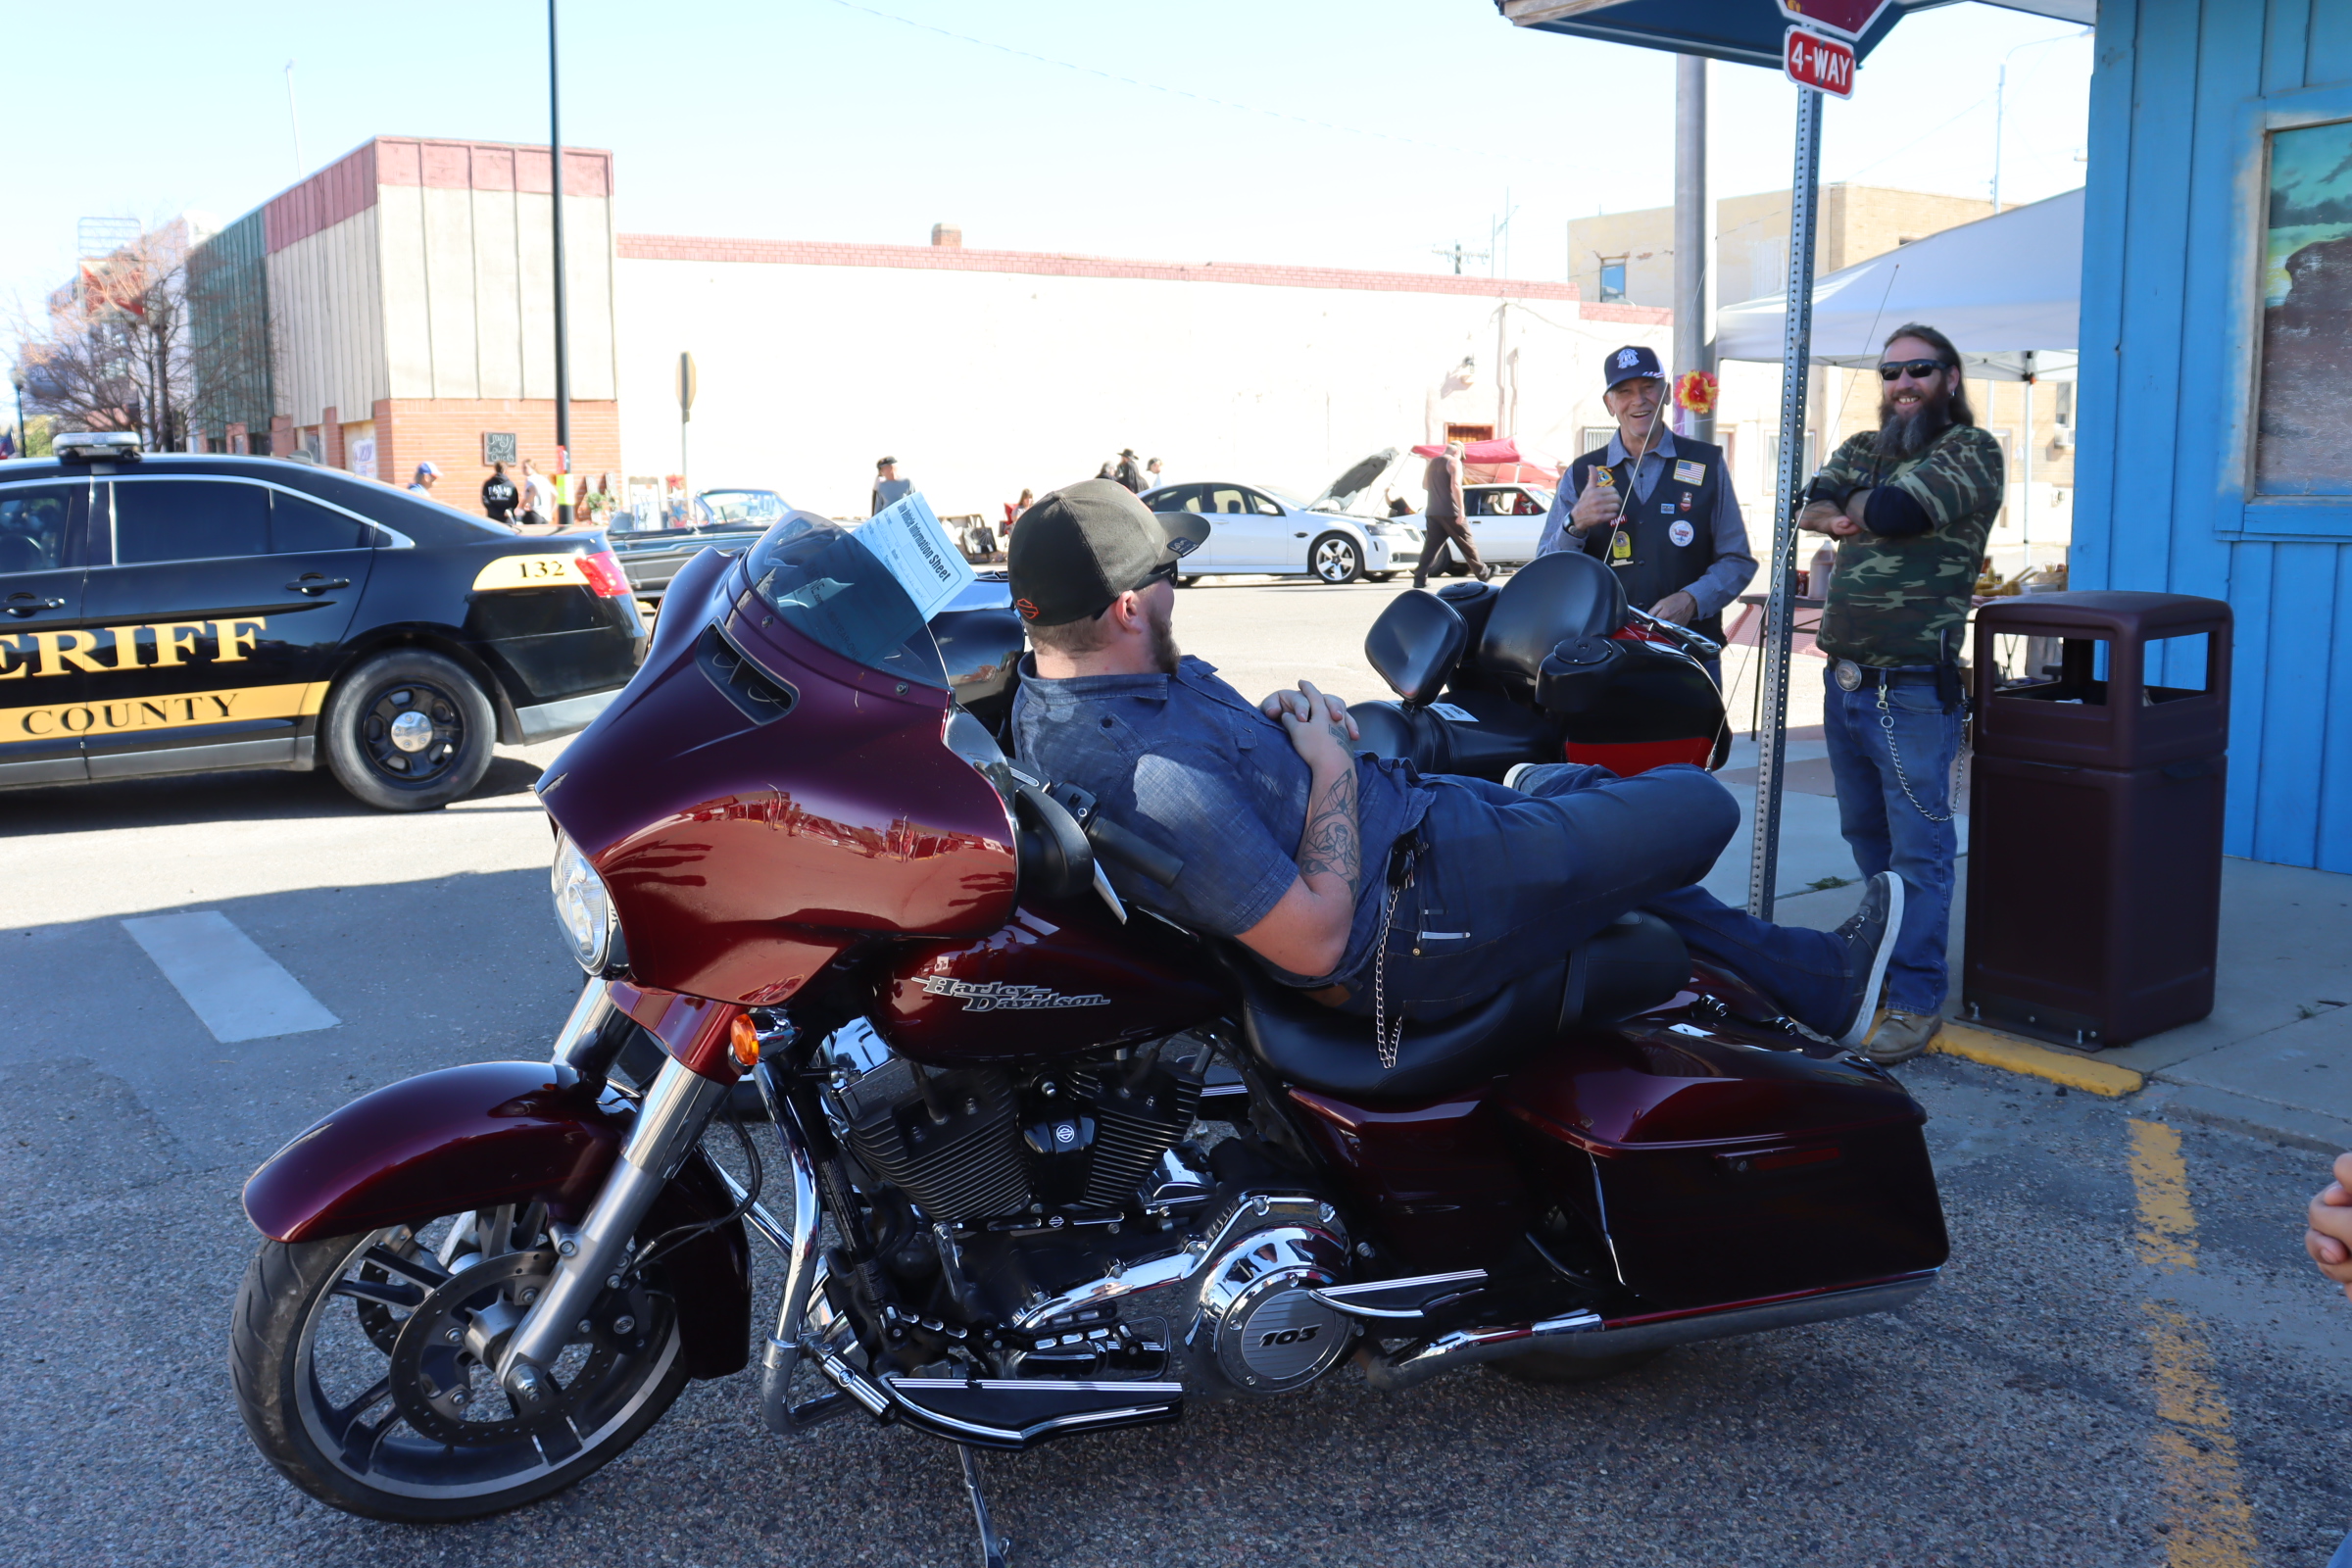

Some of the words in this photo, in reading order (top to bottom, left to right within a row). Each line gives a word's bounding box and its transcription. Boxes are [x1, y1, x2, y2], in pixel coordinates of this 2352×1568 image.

[1791, 41, 1850, 86] 4-WAY
[901, 509, 915, 528] Vehicle
[908, 522, 934, 560] Information
[928, 554, 952, 582] Sheet
[518, 561, 564, 578] 132
[0, 616, 267, 680] ERIFF
[21, 692, 239, 735] COUNTY
[911, 975, 1052, 997] Harley
[961, 992, 1111, 1011] Davidson
[1258, 1323, 1323, 1348] 103
